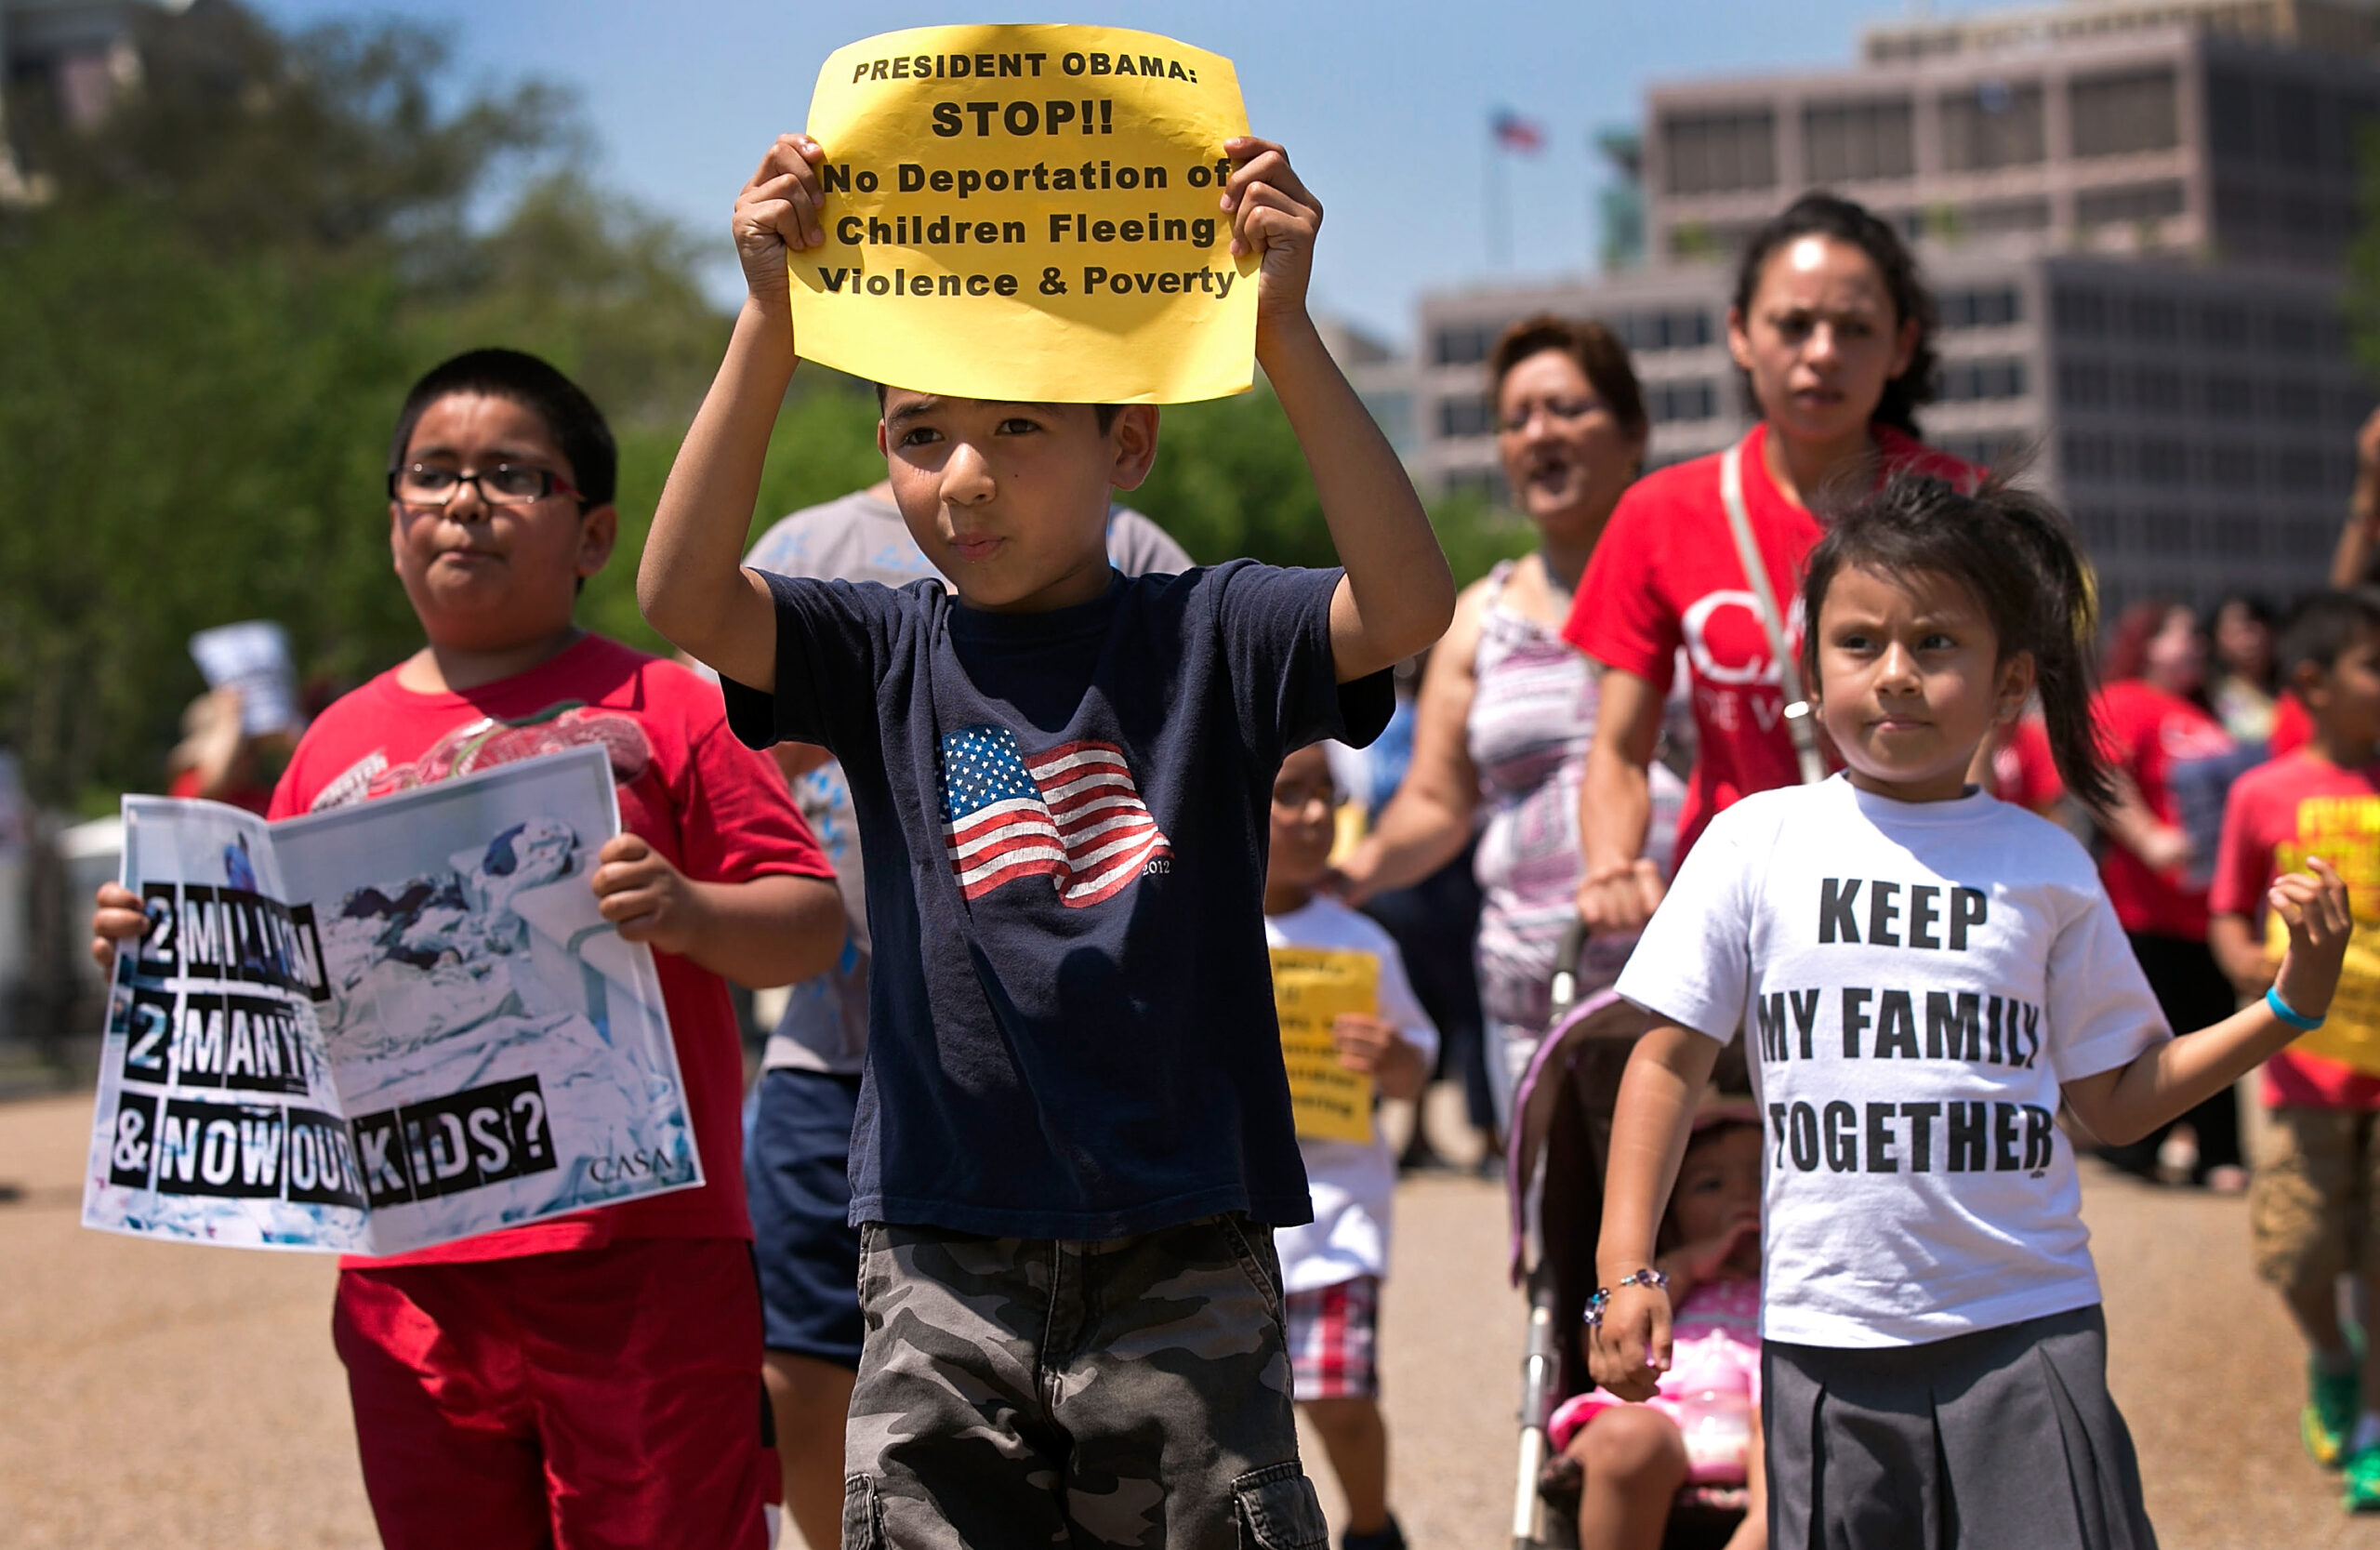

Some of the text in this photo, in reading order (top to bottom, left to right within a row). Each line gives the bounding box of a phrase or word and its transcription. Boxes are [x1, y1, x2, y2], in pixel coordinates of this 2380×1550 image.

[853, 52, 1197, 84] PRESIDENT OBAMA:
[932, 99, 1113, 138] STOP!!
[822, 157, 1231, 198] No Deportation of
[837, 212, 1216, 248] Children Fleeing
[818, 265, 1236, 299] Violence & Poverty
[1143, 860, 1170, 876] 2012
[1818, 878, 1988, 951] KEEP
[141, 895, 323, 988] 2 MILLION
[127, 1002, 301, 1079] 2 MANY
[1757, 987, 2039, 1069] MY FAMILY
[112, 1090, 545, 1198] & NOW OUR KIDS?
[1769, 1100, 2053, 1173] TOGETHER
[589, 1146, 673, 1184] CASA
